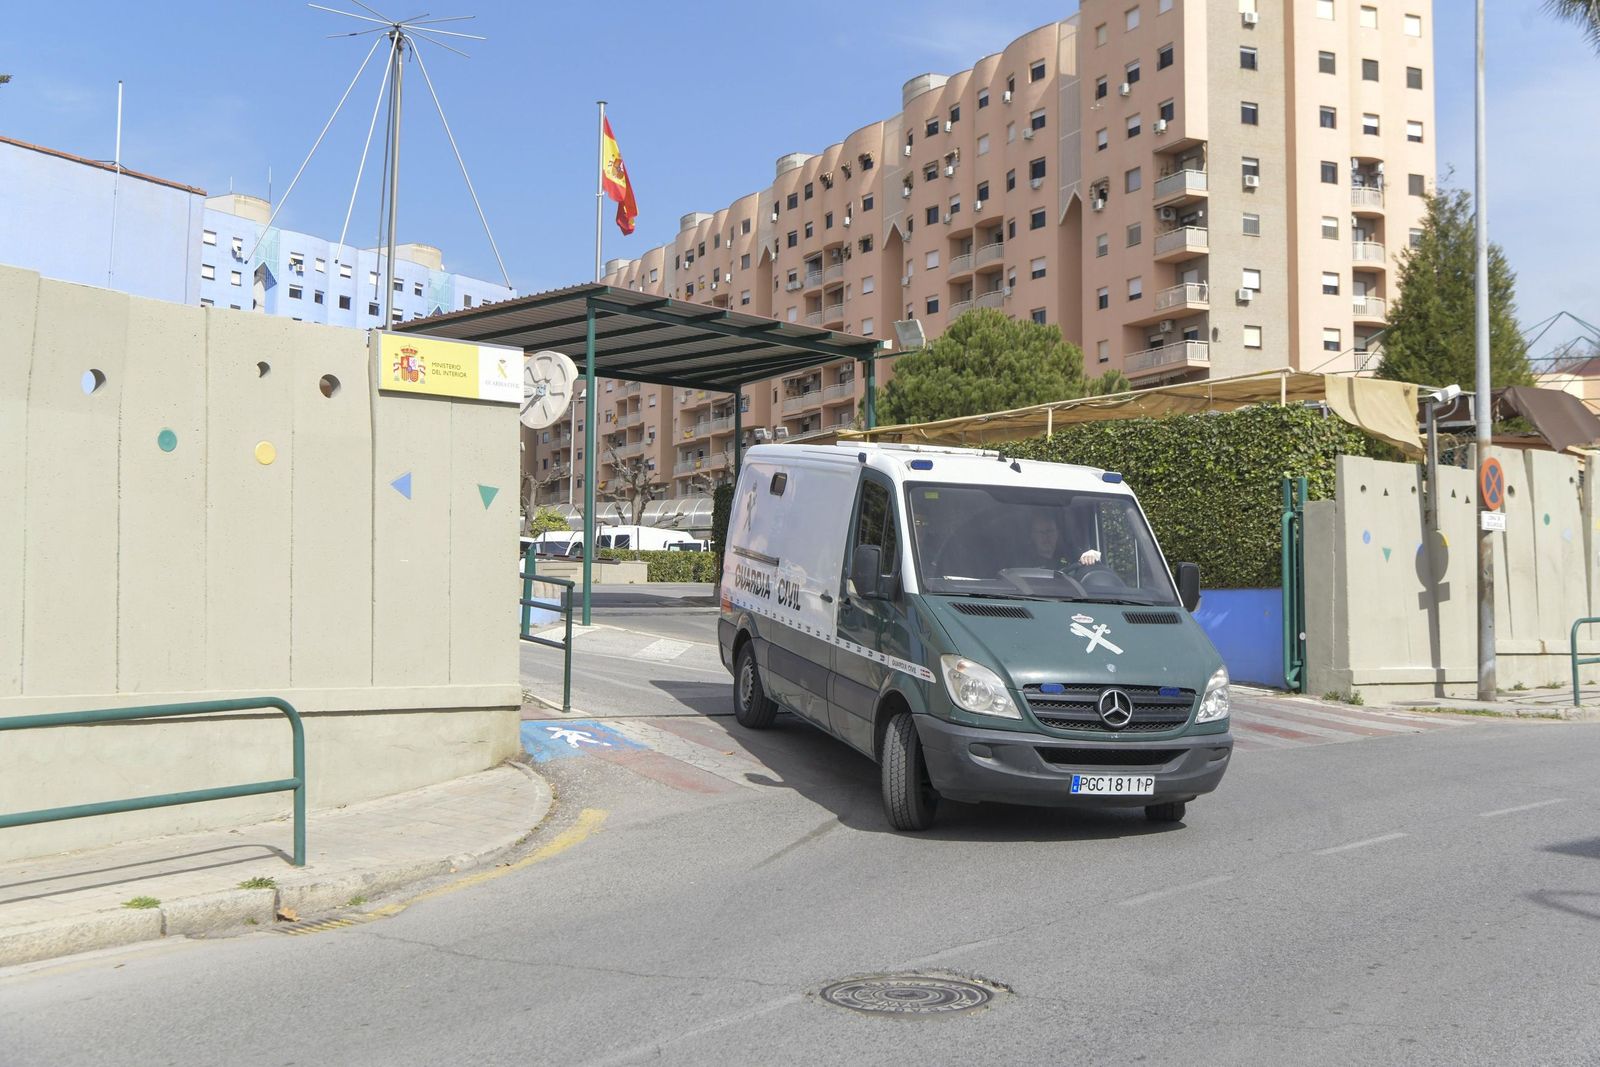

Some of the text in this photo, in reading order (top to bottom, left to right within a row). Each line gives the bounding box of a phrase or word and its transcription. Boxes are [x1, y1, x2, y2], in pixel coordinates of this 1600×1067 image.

[431, 362, 461, 370] MINISTERIO
[736, 564, 800, 611] GUARDIA CIVIL
[1079, 777, 1153, 792] PGC1811P
